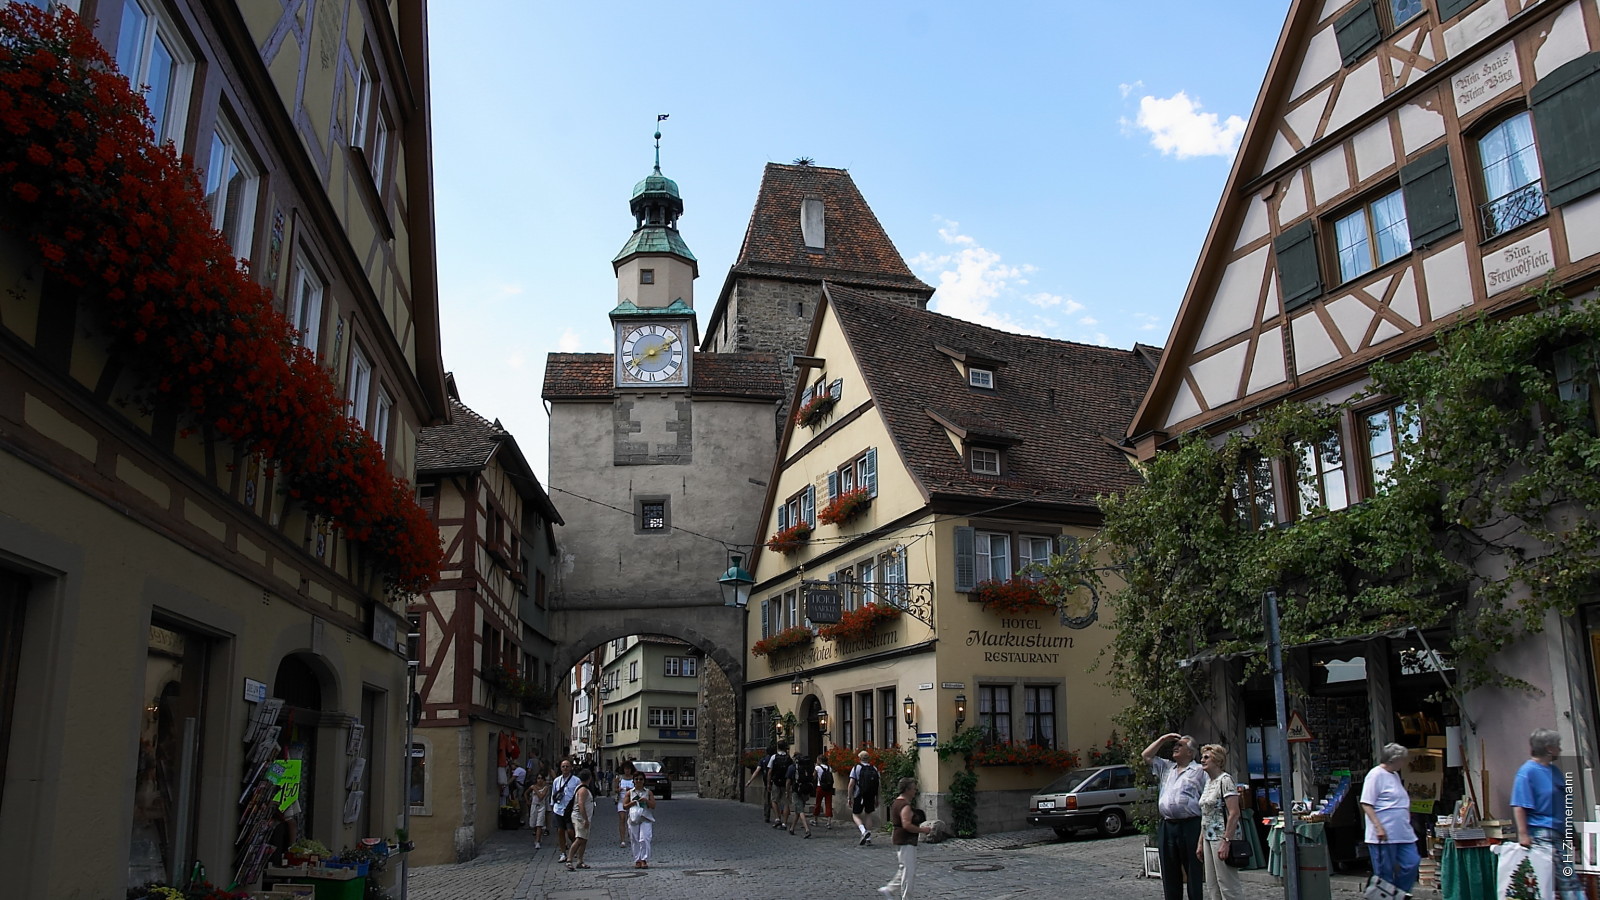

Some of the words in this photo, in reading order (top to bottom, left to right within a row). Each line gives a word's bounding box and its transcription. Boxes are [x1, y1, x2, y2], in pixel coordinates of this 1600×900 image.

[1455, 72, 1480, 89] Mein
[1458, 86, 1485, 104] Meine
[1484, 69, 1513, 89] Burg
[1001, 618, 1041, 629] HOTEL
[835, 630, 899, 659] Markusturm
[966, 630, 1074, 648] Markusturm
[984, 652, 1060, 664] RESTAURANT
